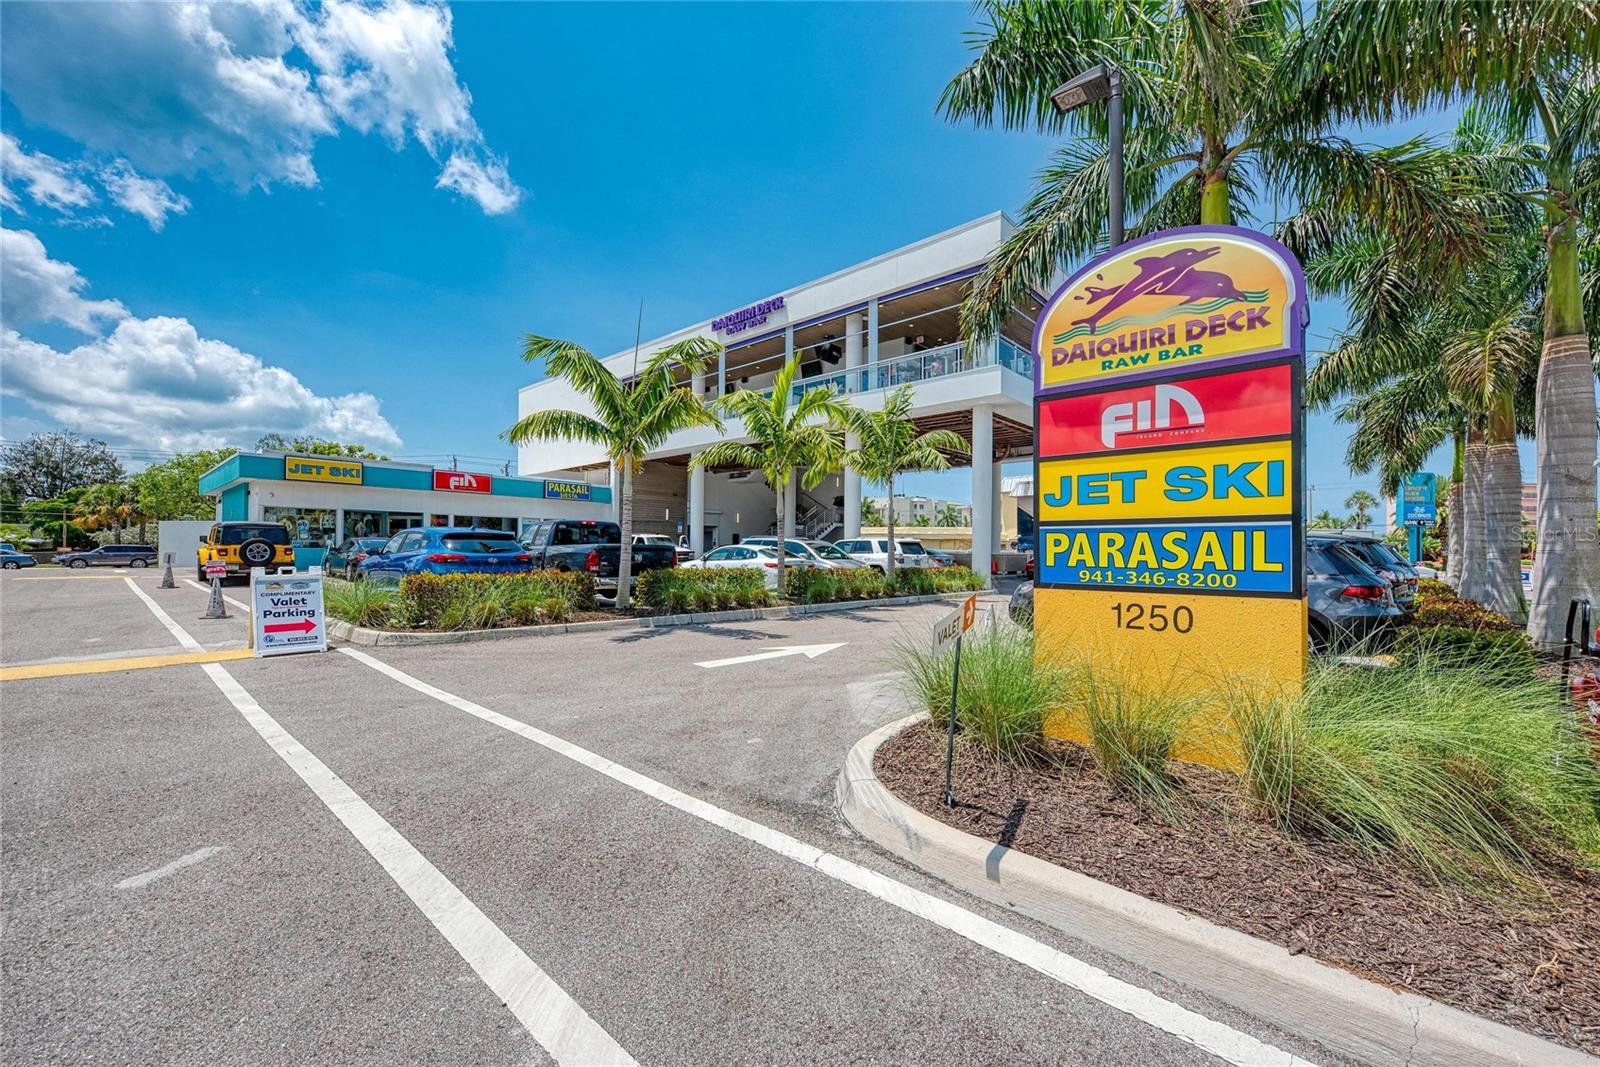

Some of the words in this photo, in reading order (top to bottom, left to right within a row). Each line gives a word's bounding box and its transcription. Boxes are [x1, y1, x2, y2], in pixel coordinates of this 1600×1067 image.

[712, 306, 756, 332] DAIQUIRI
[757, 296, 785, 315] DECK
[1051, 324, 1176, 367] DAIQUIRI
[1185, 306, 1272, 342] DECK
[1101, 352, 1150, 371] RAW
[1158, 343, 1203, 362] BAR
[1169, 428, 1205, 437] COMPANY
[288, 463, 325, 475] JET
[329, 466, 361, 478] SKI
[548, 482, 589, 495] PARASAIL
[1043, 469, 1147, 507] JET
[1163, 459, 1285, 502] SKI
[1044, 529, 1284, 573] PARASAIL
[1078, 569, 1237, 588] 941-346-8200
[260, 590, 316, 598] COMPLIMENTARY
[271, 597, 307, 606] Valet
[263, 608, 315, 619] Parking
[1111, 603, 1193, 633] 1250
[937, 615, 961, 646] VALET
